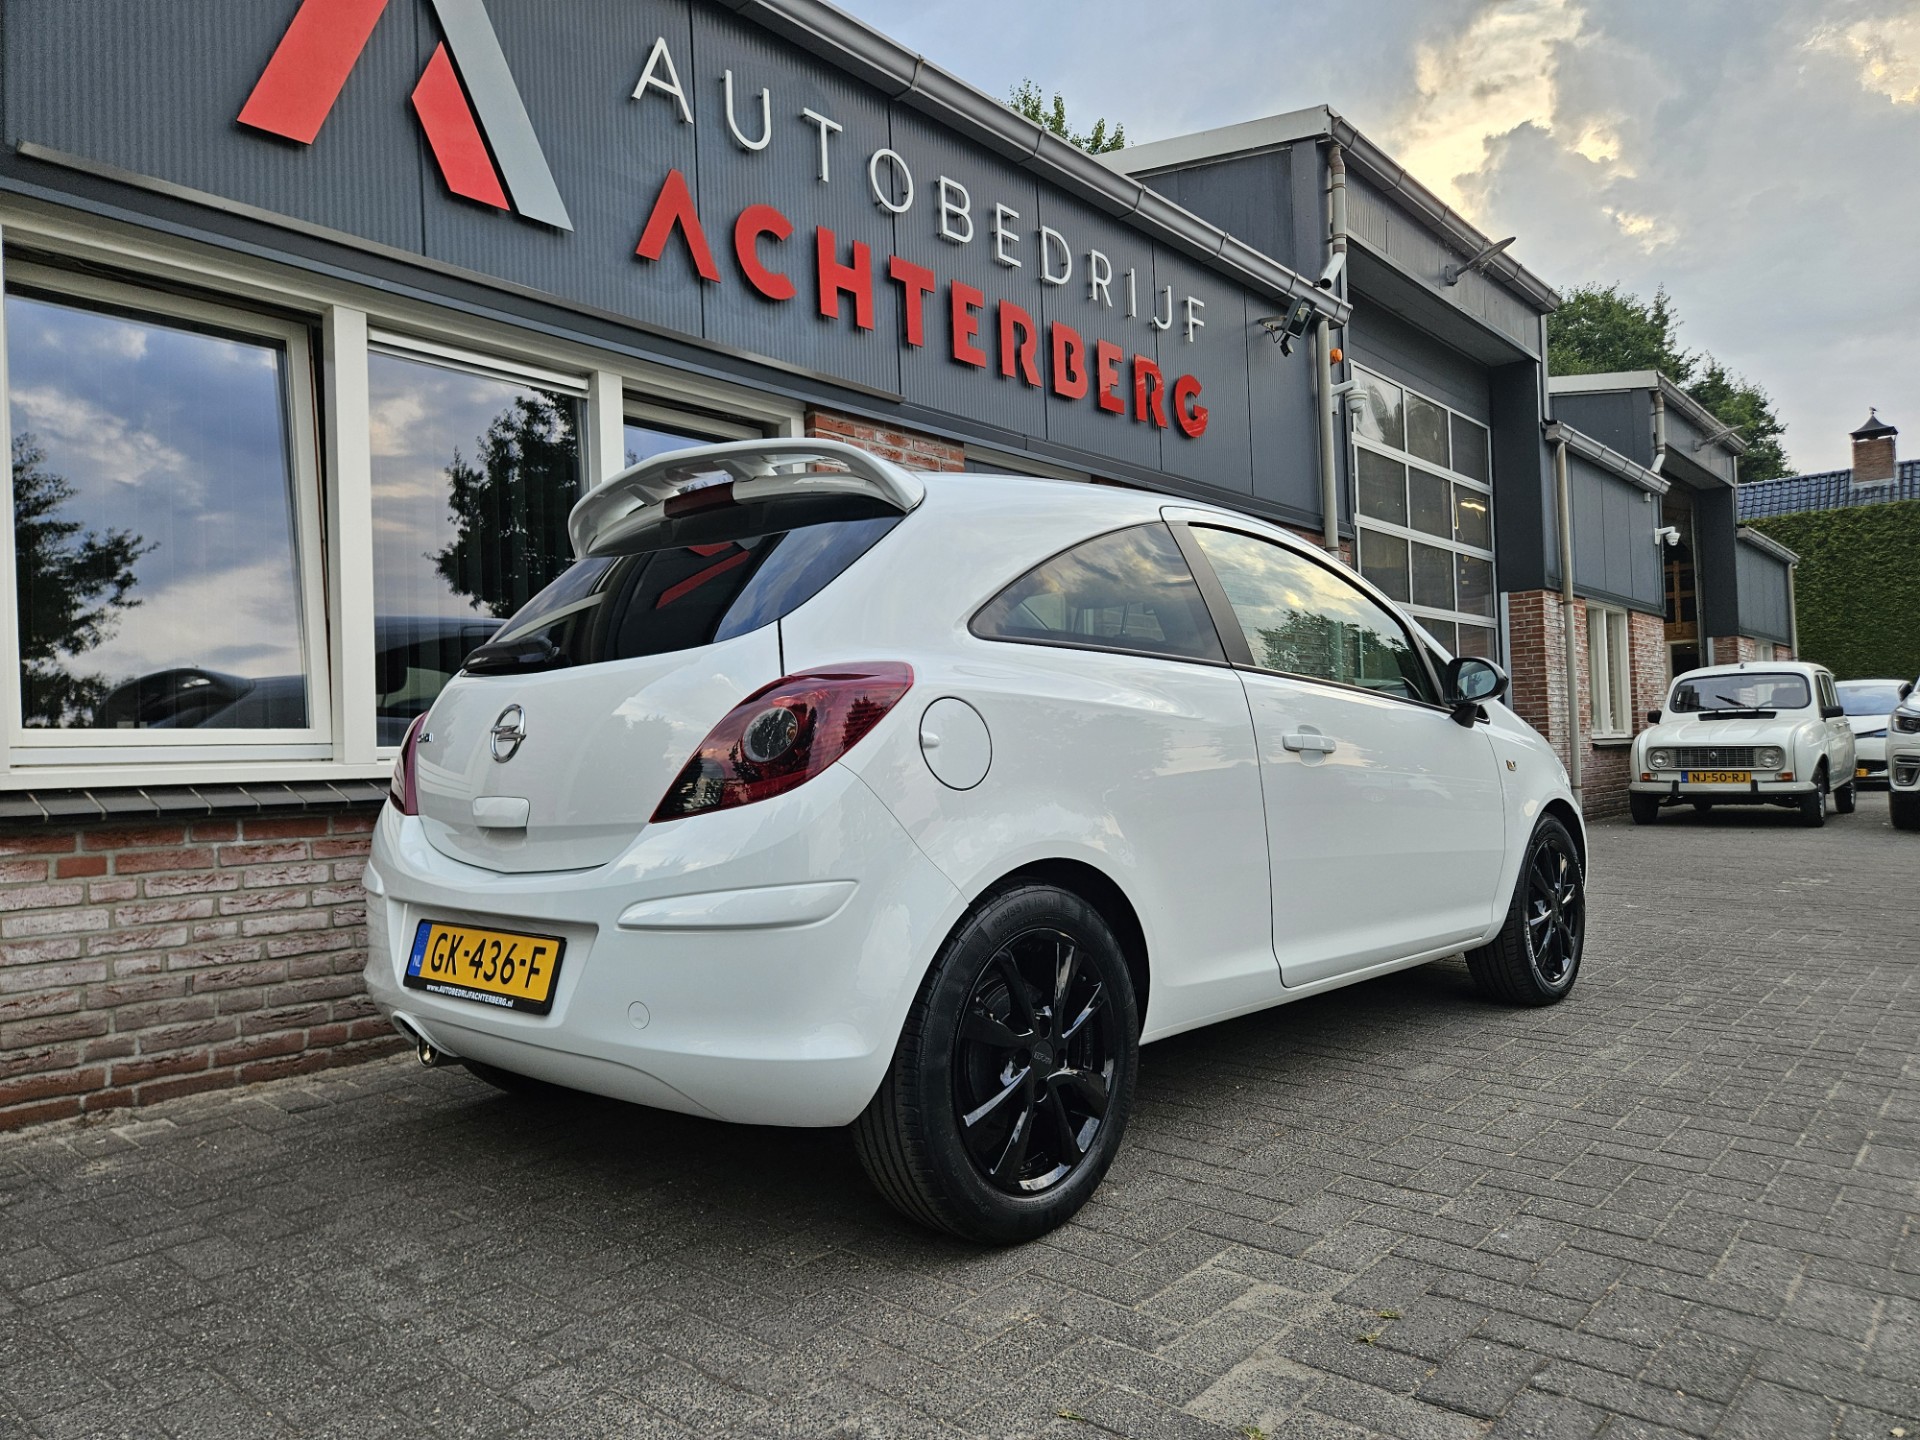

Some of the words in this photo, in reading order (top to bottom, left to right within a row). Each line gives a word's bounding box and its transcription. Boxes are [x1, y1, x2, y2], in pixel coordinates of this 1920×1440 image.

[632, 37, 1206, 343] AUTOBEDRIJF
[635, 168, 1209, 439] ACHTERBERG
[1692, 773, 1746, 783] NJ-50-RJ
[412, 954, 421, 968] NL
[430, 932, 547, 989] GK-436-F
[426, 984, 515, 1009] www.AUTOBEDRIJFACHTERBERG.nl
